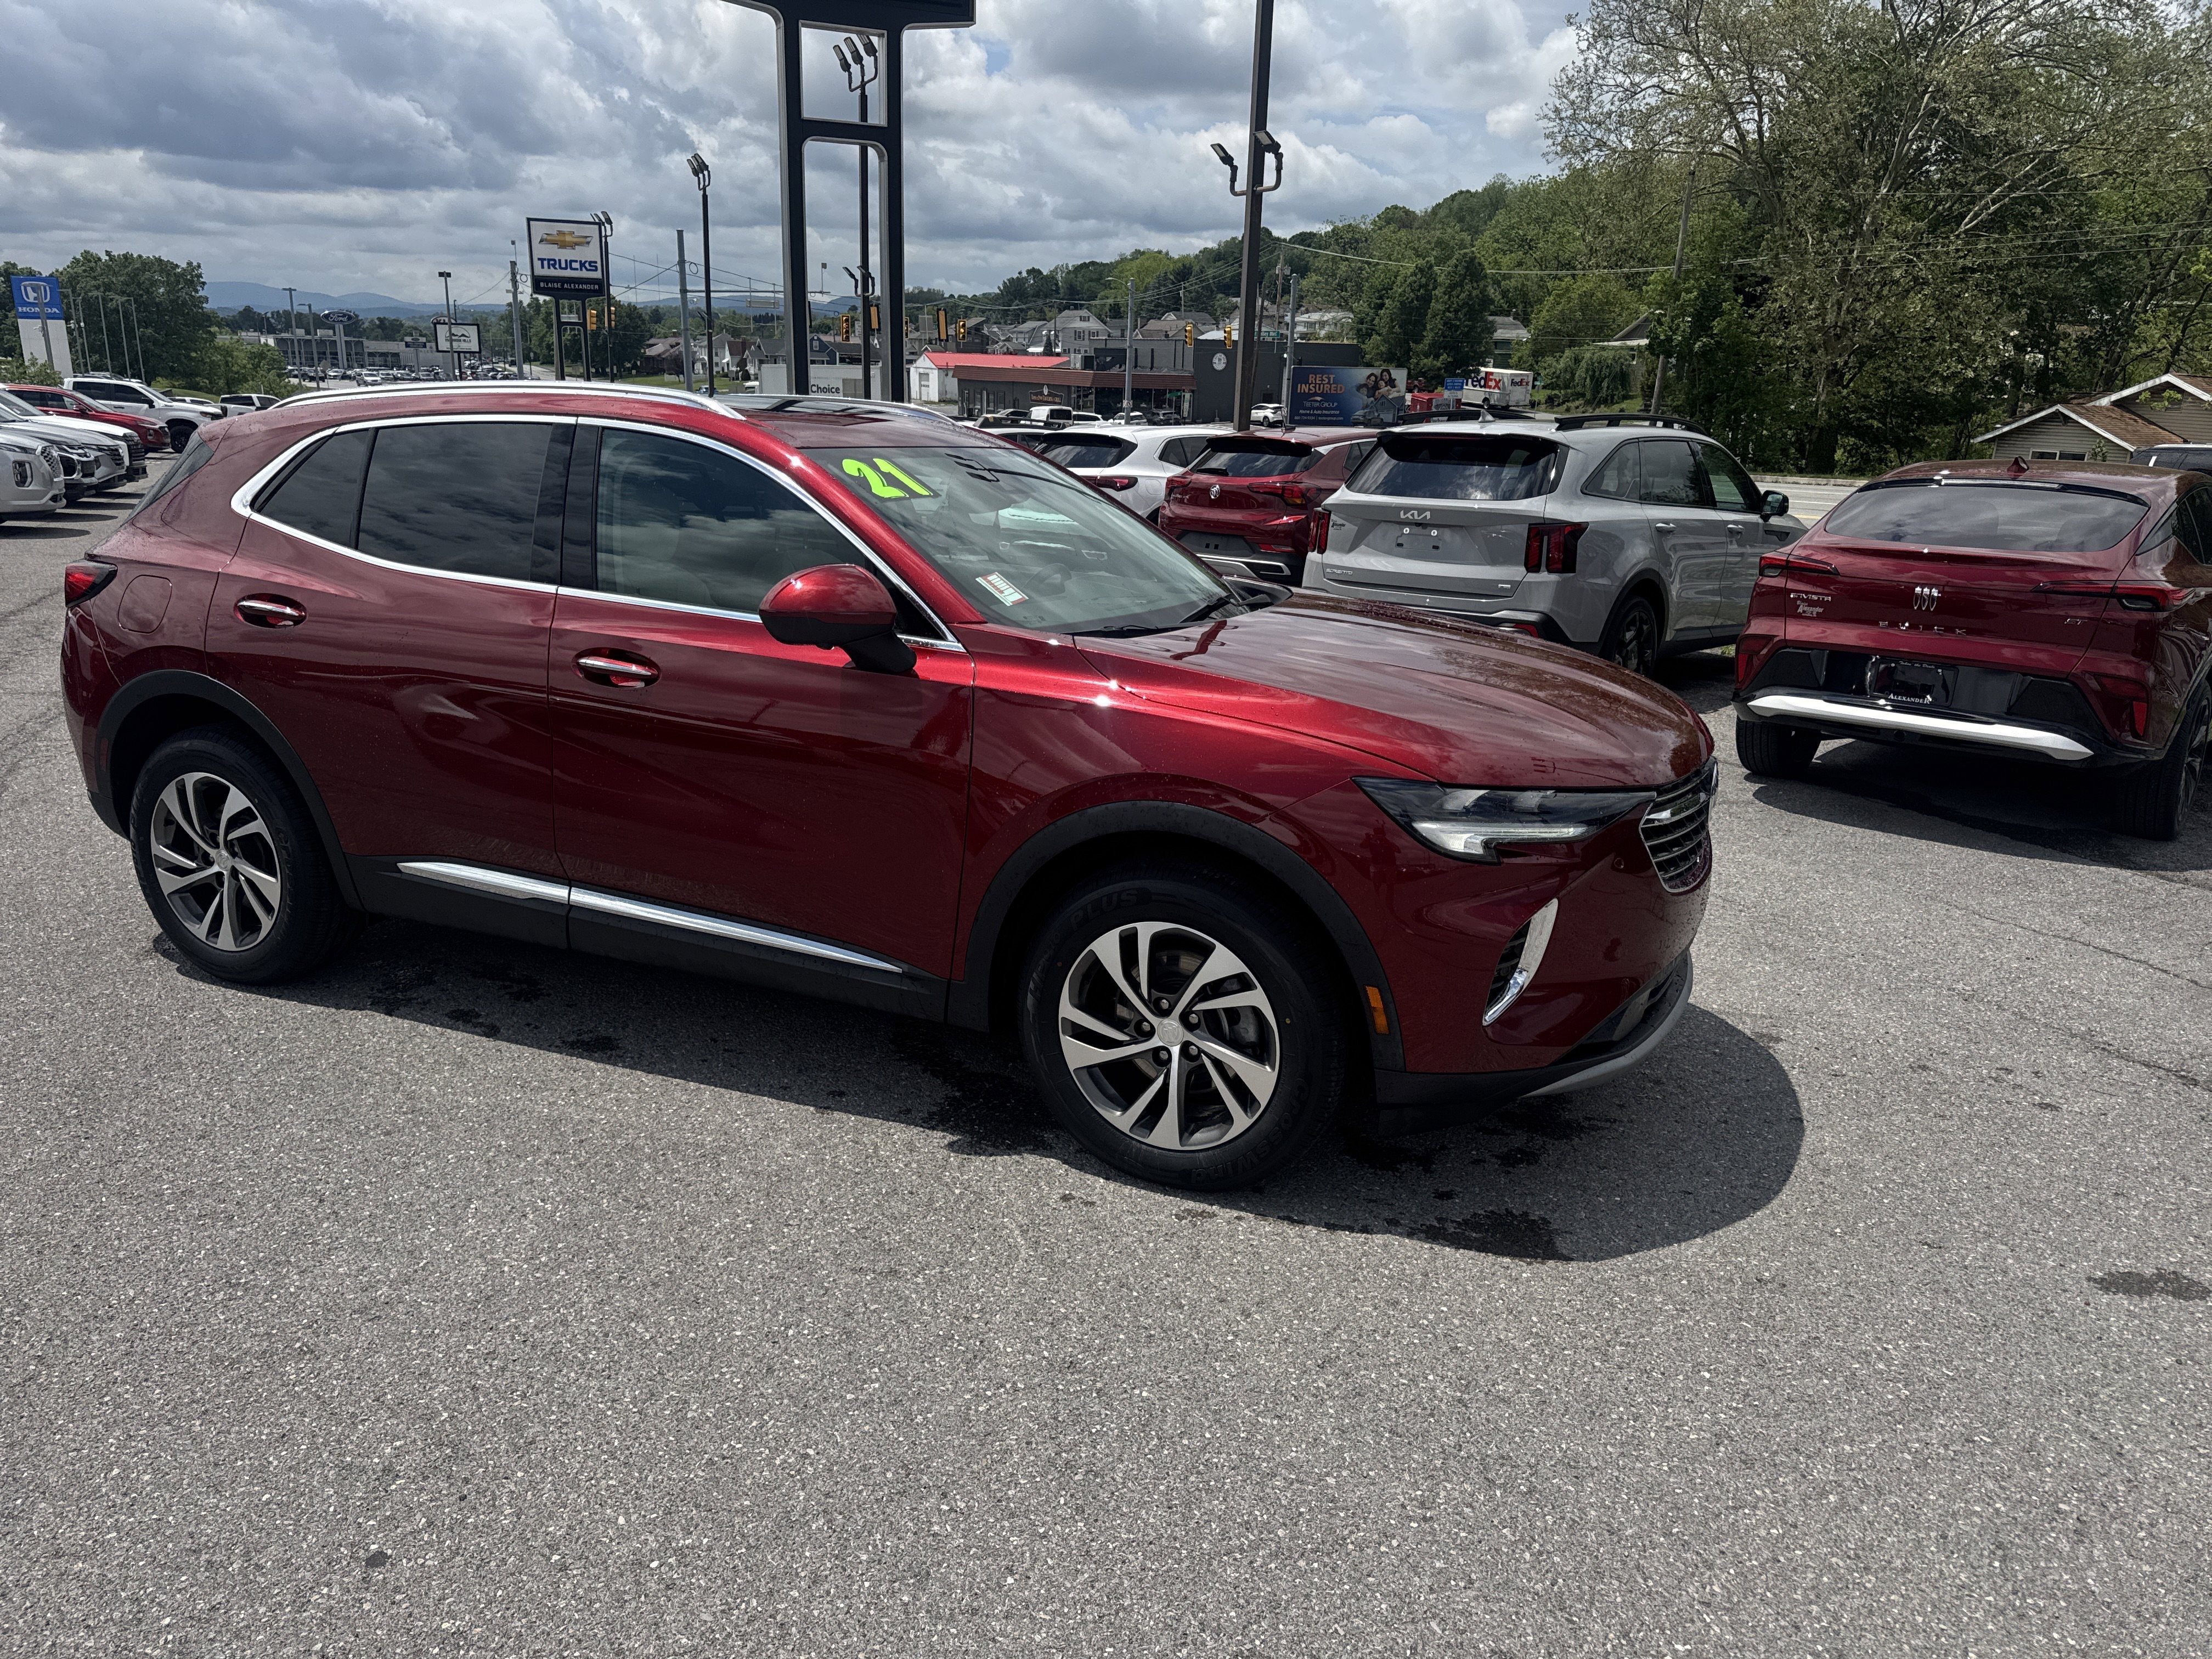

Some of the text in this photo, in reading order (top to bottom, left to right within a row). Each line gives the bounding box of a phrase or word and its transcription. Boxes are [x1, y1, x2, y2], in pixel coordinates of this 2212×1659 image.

[538, 257, 598, 272] TRUCKS
[328, 313, 348, 321] Ford
[1308, 374, 1335, 383] REST
[1510, 379, 1530, 387] FedEx
[810, 384, 840, 394] Choice
[1297, 383, 1345, 393] INSURED
[842, 458, 933, 498] 21
[1878, 621, 1967, 636] BUICK
[1888, 693, 1931, 704] ALEXANDER
[1069, 889, 1138, 932] PLUS
